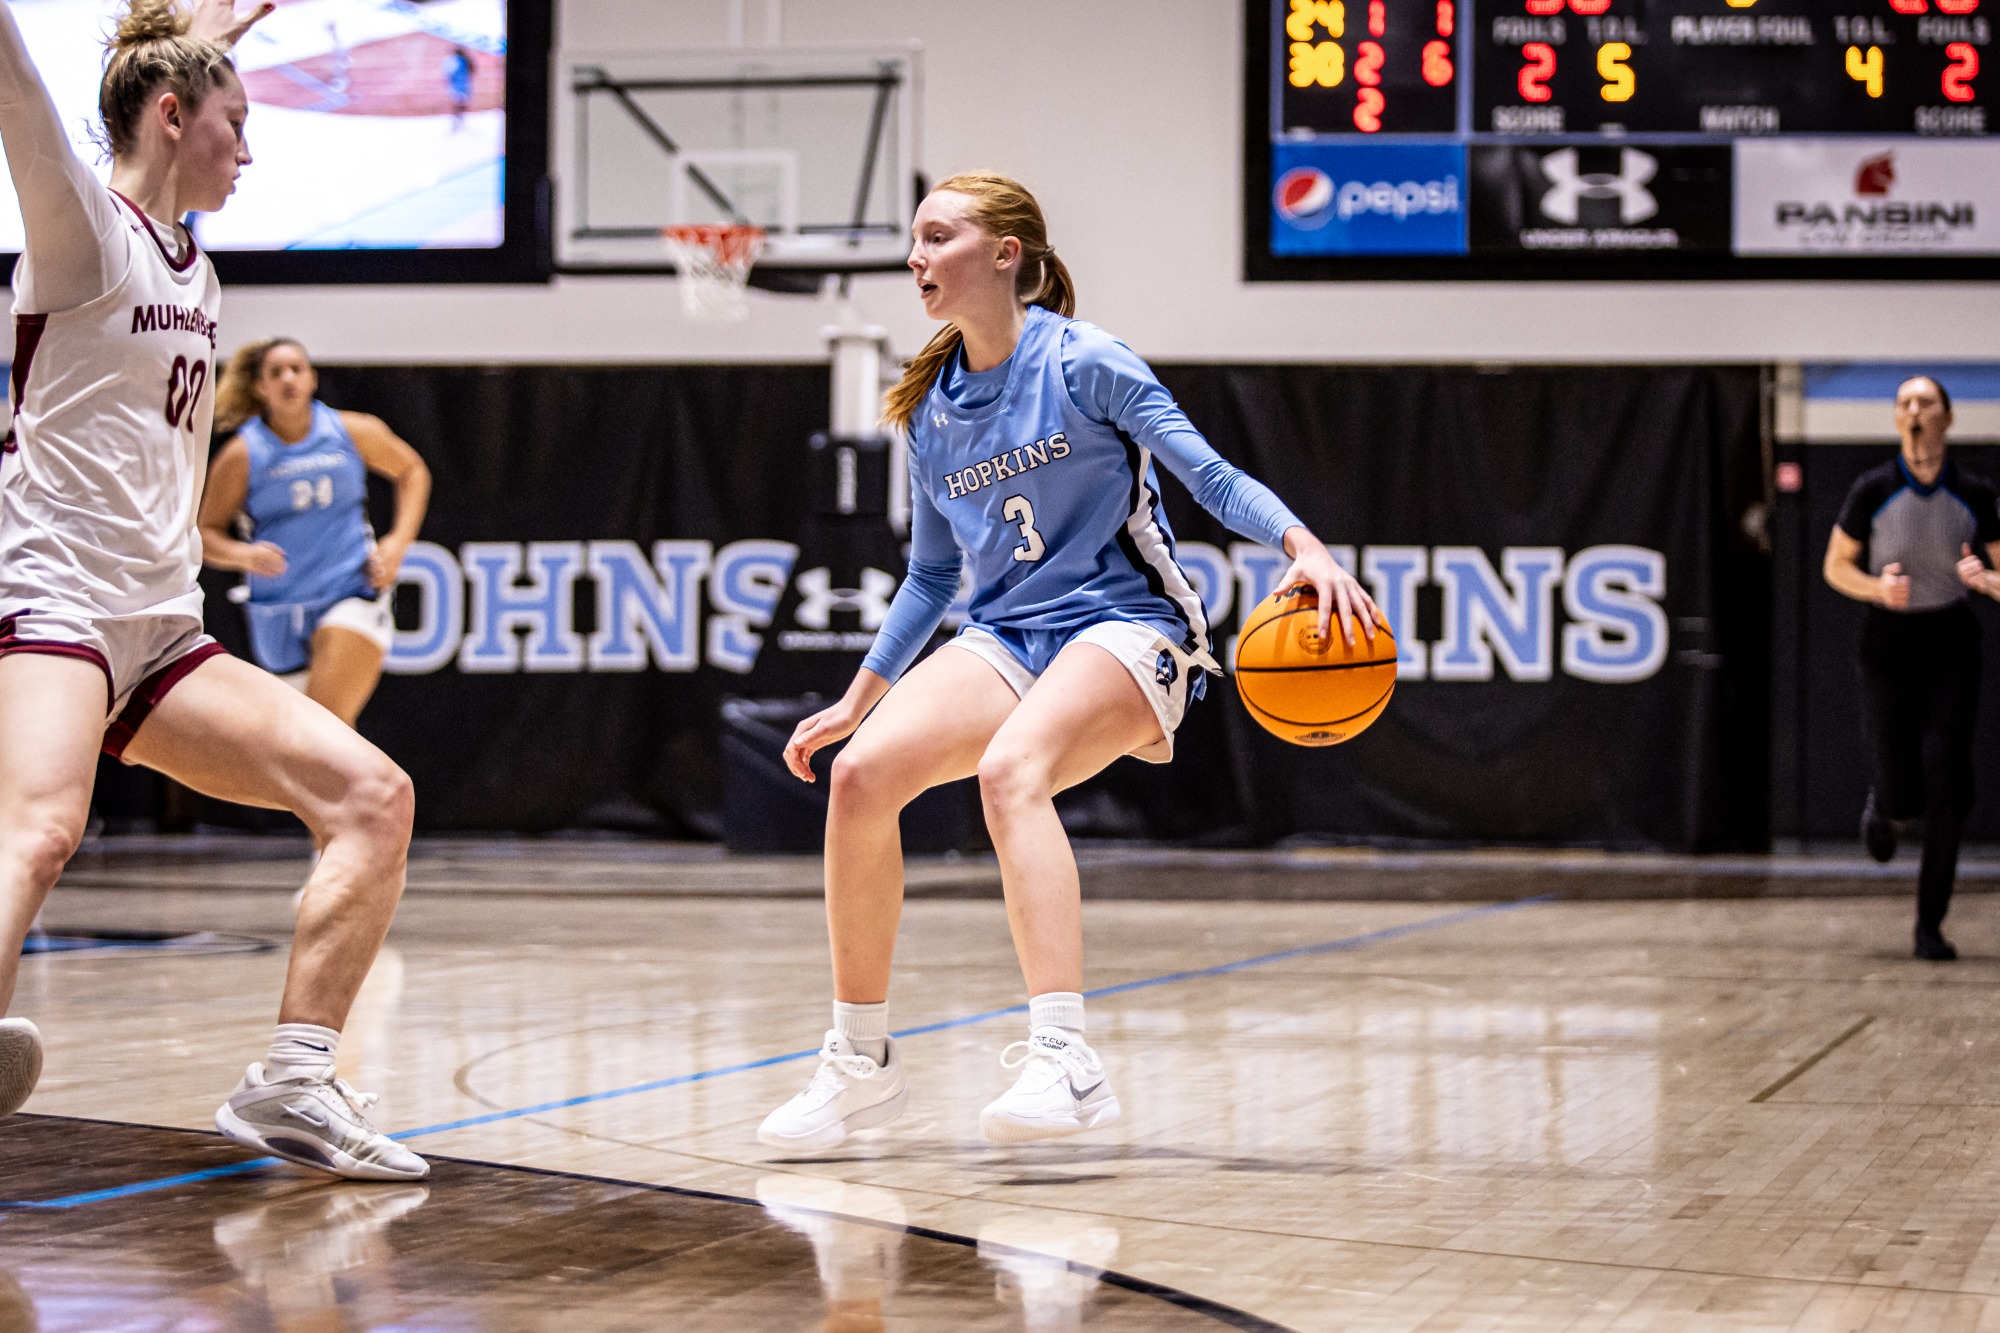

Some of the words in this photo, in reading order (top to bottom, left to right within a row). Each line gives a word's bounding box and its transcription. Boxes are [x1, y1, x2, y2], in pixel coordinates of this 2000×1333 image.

[1354, 40, 1386, 86] 2
[1422, 40, 1454, 87] 6
[1518, 42, 1557, 102] 2
[1597, 42, 1636, 102] 5
[1845, 46, 1884, 98] 4
[1941, 42, 1979, 102] 2
[1353, 87, 1386, 133] 2
[1337, 175, 1459, 221] pepsi
[944, 432, 1071, 499] HOPKINS
[1002, 494, 1046, 562] 3
[383, 540, 798, 673] OHNS
